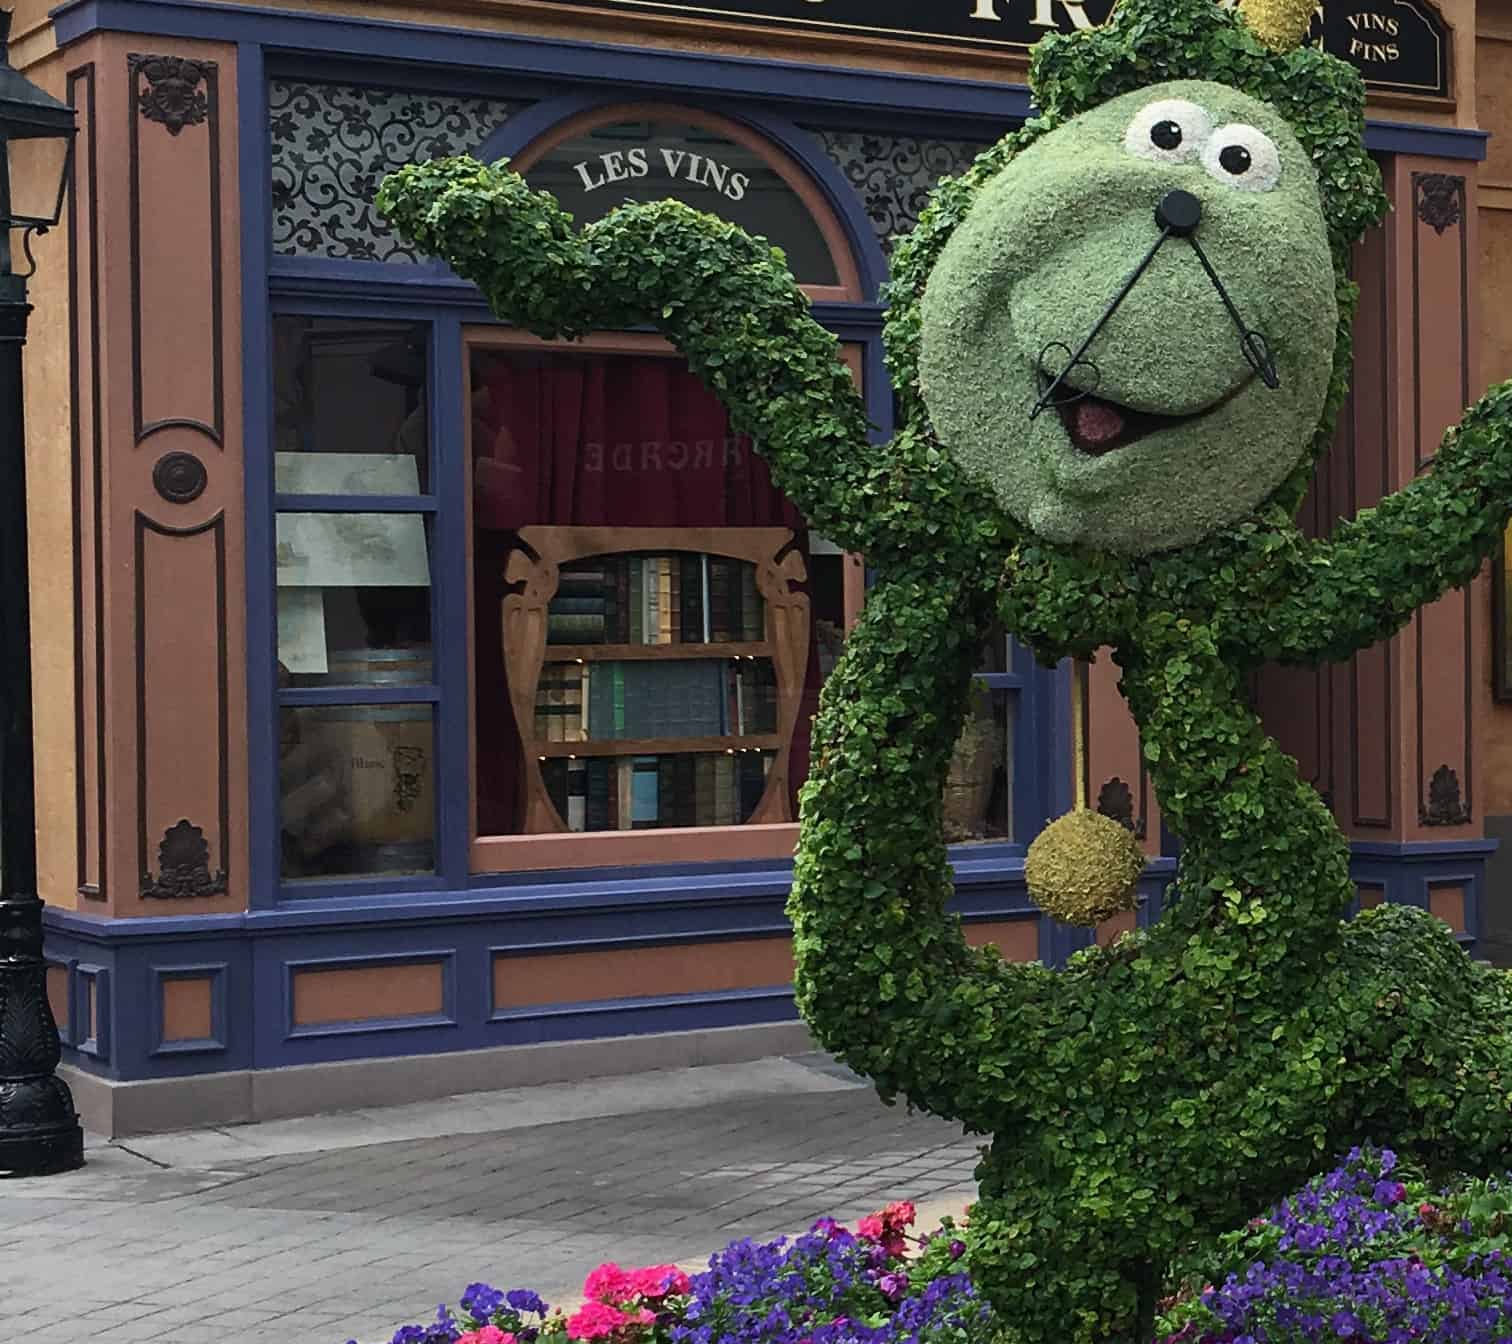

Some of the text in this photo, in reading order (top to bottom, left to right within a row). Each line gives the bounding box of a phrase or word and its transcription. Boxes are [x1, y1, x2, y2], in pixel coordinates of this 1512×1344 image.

[1345, 13, 1400, 36] VINS
[1350, 38, 1400, 63] FINS
[573, 148, 750, 201] LES VINS
